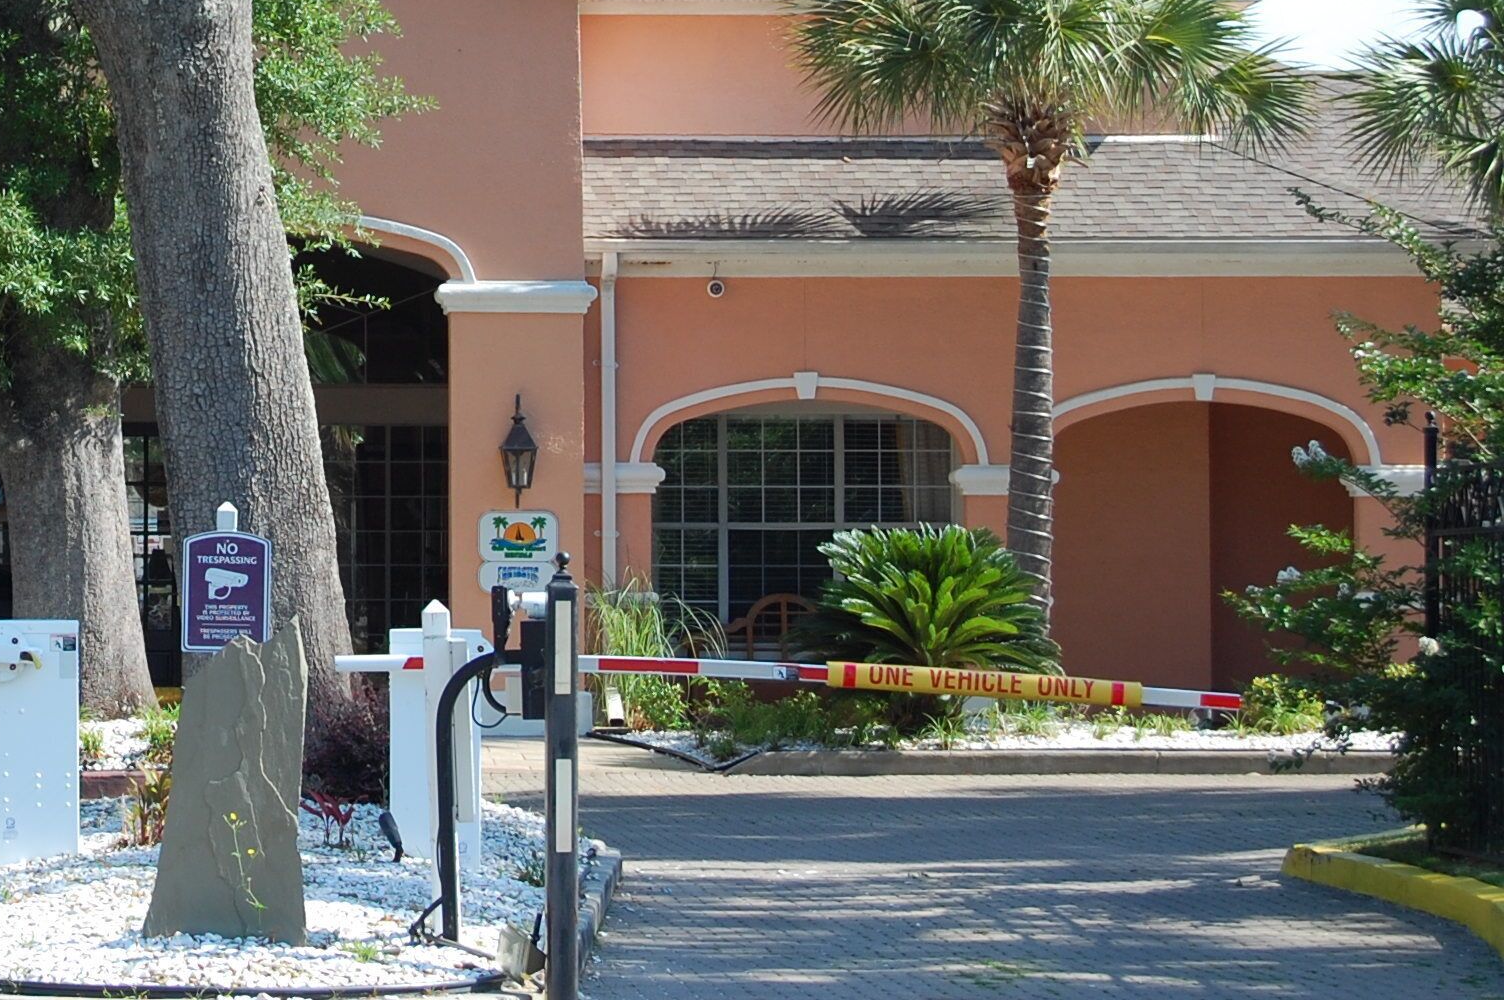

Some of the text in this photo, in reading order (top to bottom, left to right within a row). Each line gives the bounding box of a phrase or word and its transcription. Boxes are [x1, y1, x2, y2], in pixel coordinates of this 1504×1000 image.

[216, 542, 238, 555] NO
[197, 555, 258, 565] TRESPASSING
[869, 665, 1095, 700] ONE VEHICLE ONLY
